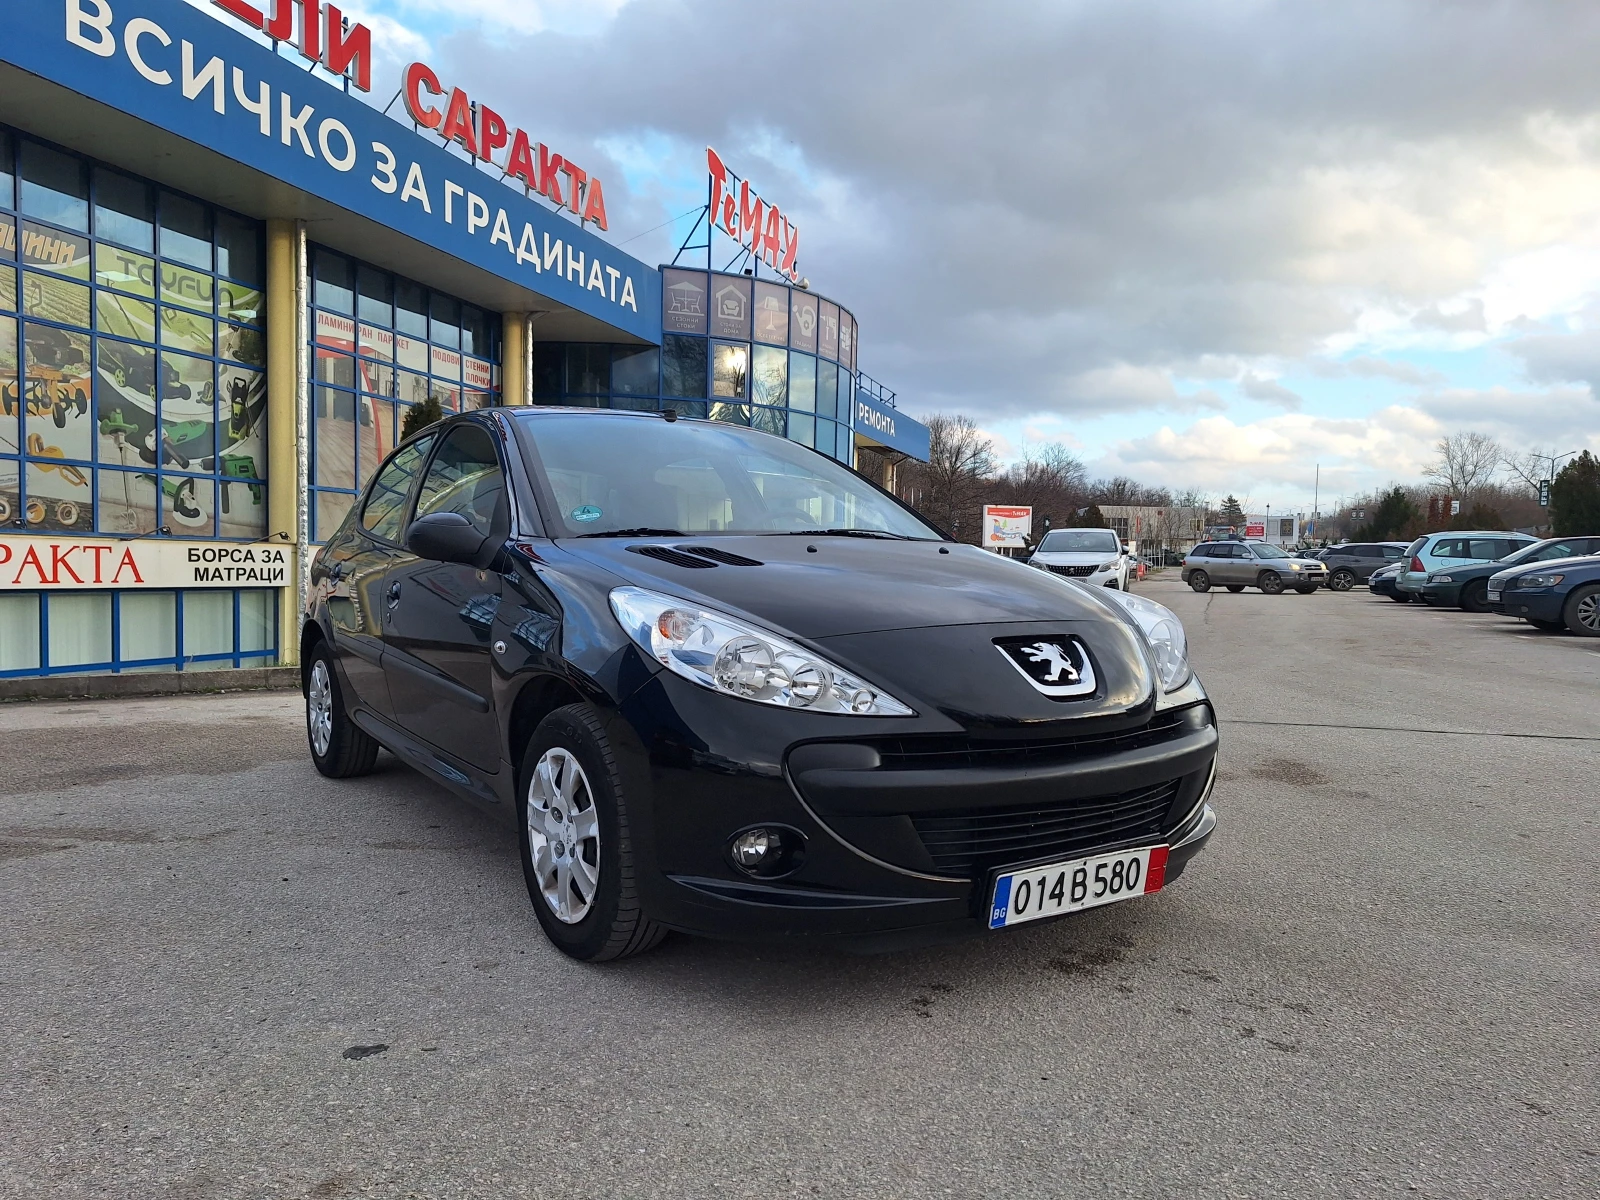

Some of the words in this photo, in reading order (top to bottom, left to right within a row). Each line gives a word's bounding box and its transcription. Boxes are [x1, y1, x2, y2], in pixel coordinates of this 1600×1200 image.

[402, 62, 608, 231] САРАКТА
[65, 0, 357, 172] ВСИЧКО
[370, 141, 432, 215] ЗА
[444, 179, 638, 313] ГРАДИНАТА
[317, 314, 373, 339] ЛАМИНИРАН
[377, 331, 410, 350] ПАРКЕТ
[432, 349, 460, 366] ПОДОВИ
[465, 359, 490, 375] СТЕННИ
[858, 402, 896, 438] РЕМОНТА
[187, 547, 256, 564] БОРСА
[261, 549, 285, 564] ЗА
[194, 566, 285, 584] МАТРАЦИ
[993, 907, 1007, 921] BG
